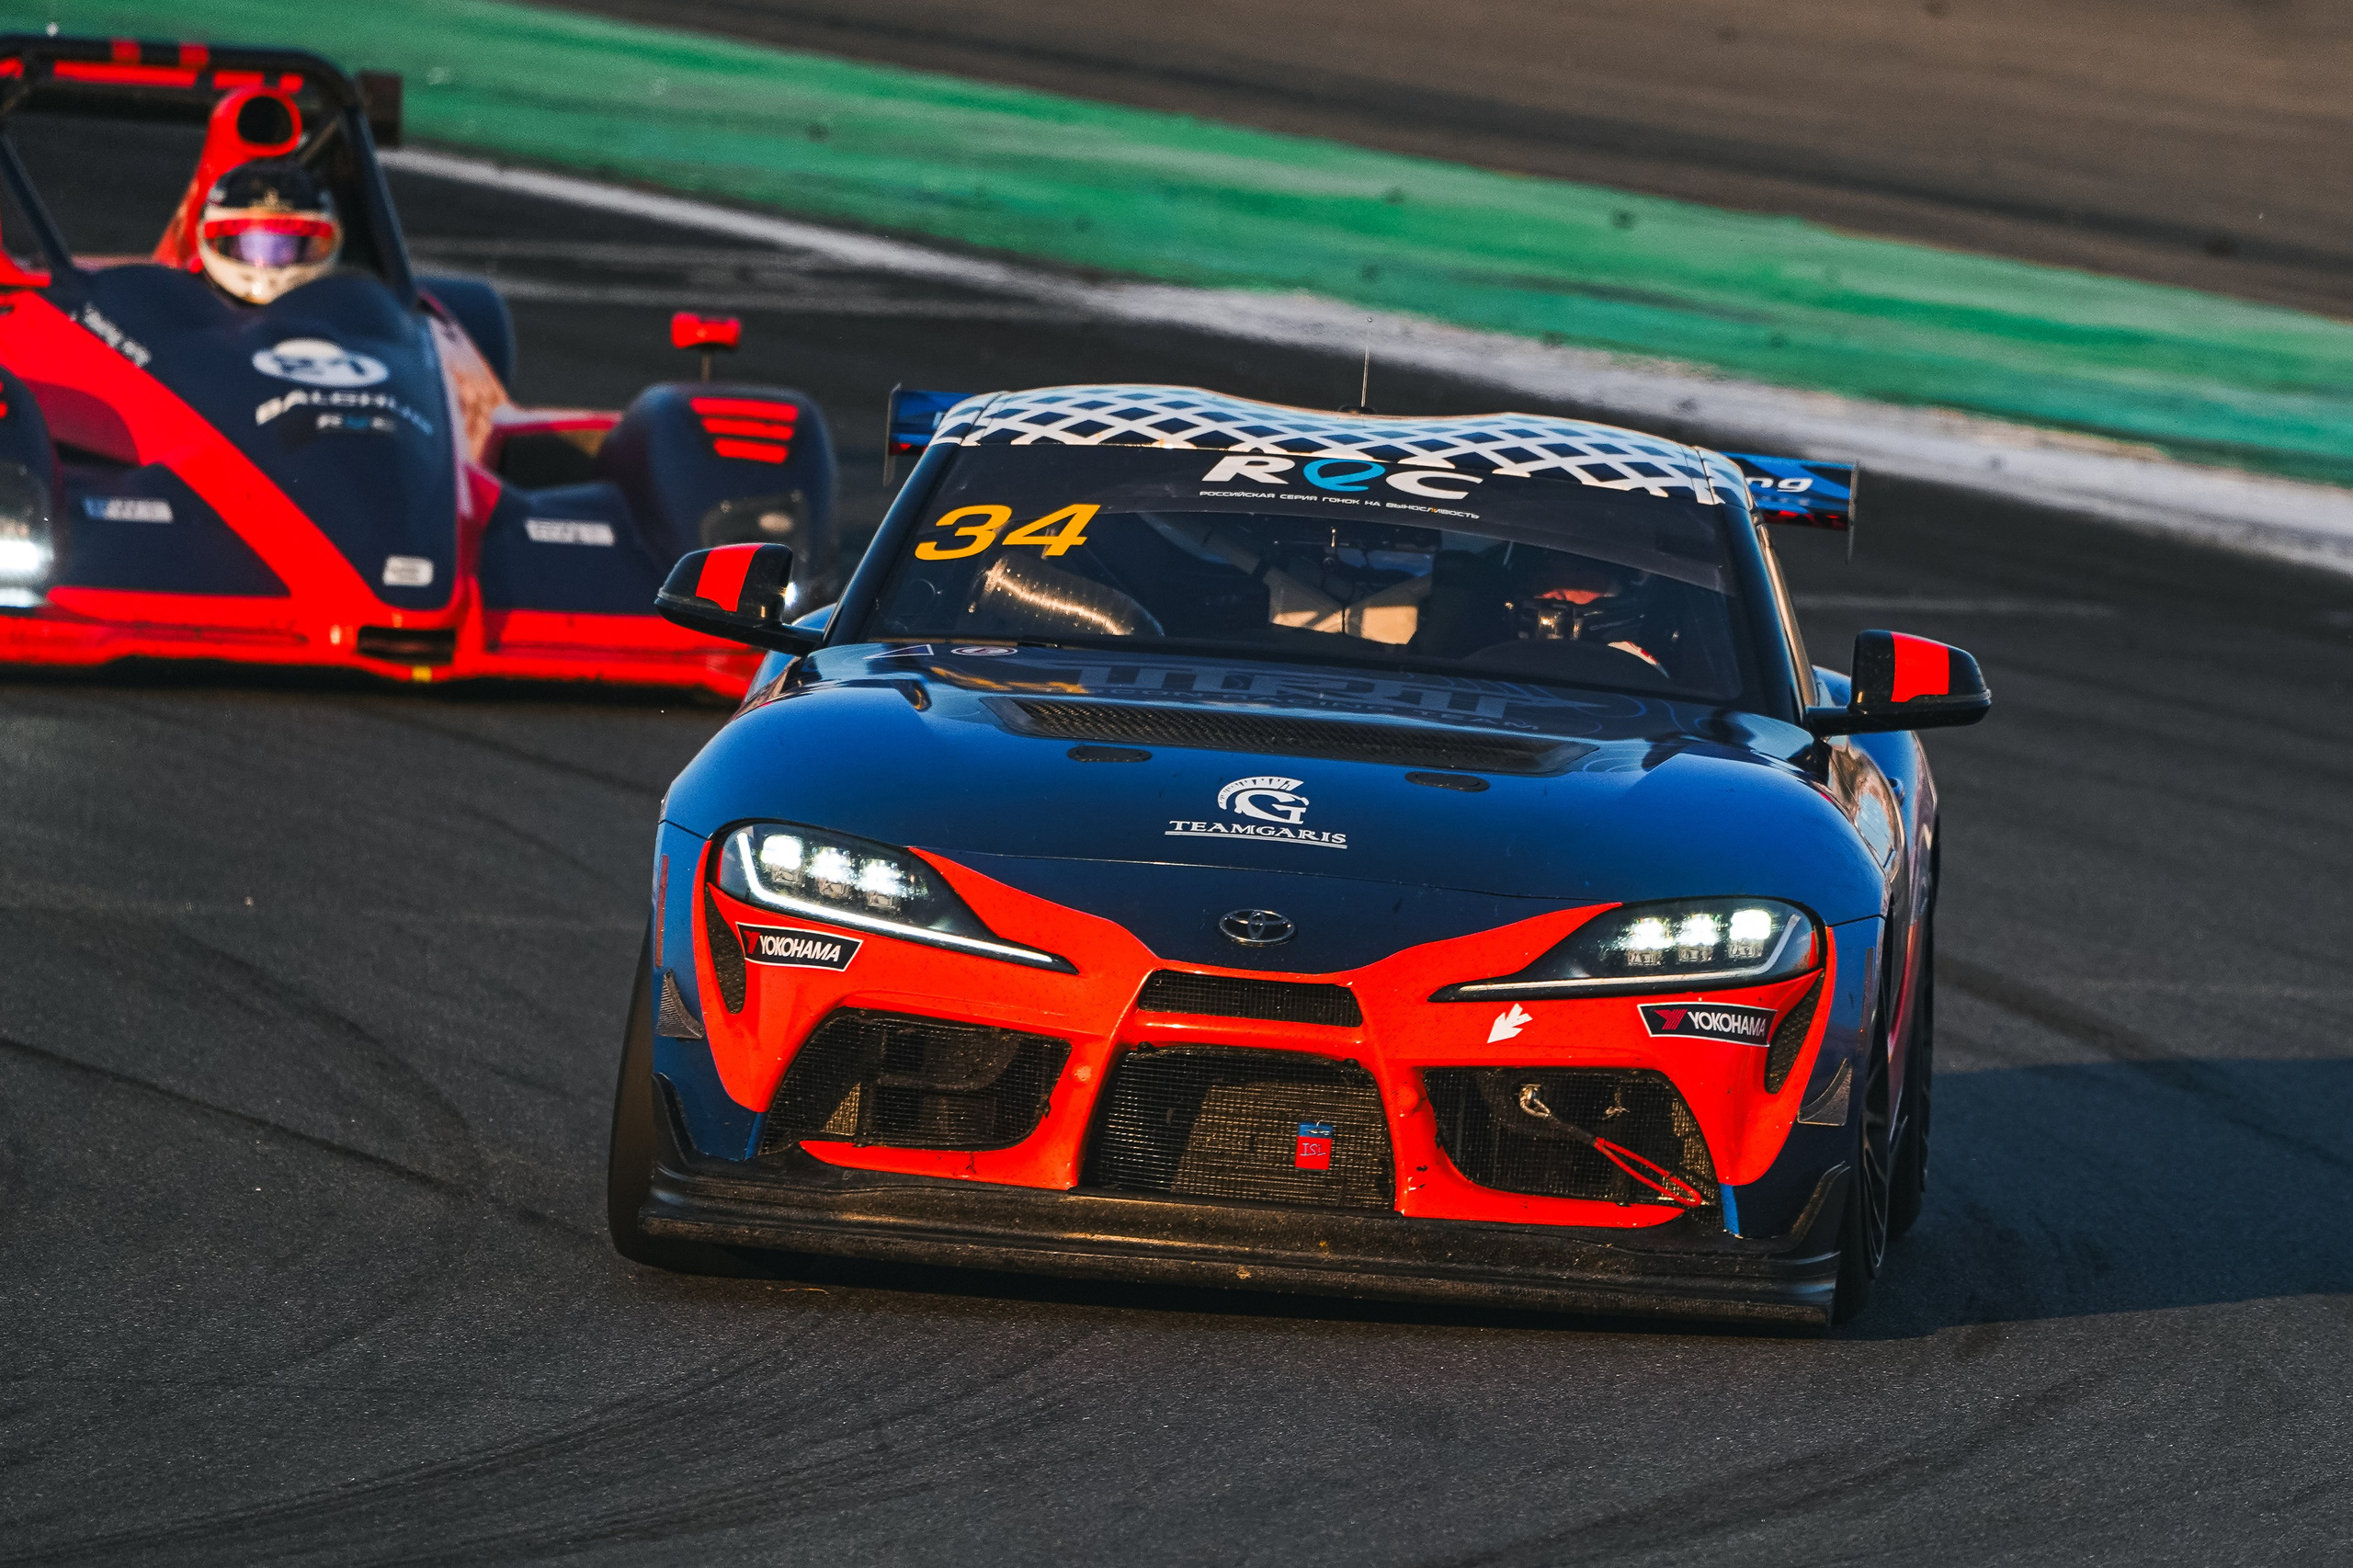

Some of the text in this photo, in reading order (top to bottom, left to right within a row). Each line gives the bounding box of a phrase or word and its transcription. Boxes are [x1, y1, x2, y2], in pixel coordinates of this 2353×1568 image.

[1199, 491, 1276, 499] РОССИЙСКАЯ
[1279, 494, 1318, 502] СЕРИЯ
[1322, 496, 1360, 505] ГОНОК
[1364, 499, 1381, 507] НА
[915, 504, 1101, 561] 34
[1169, 820, 1347, 844] TEAMGARIS
[759, 935, 842, 962] YOKOHAMA
[1687, 1011, 1767, 1038] YOKOHAMA
